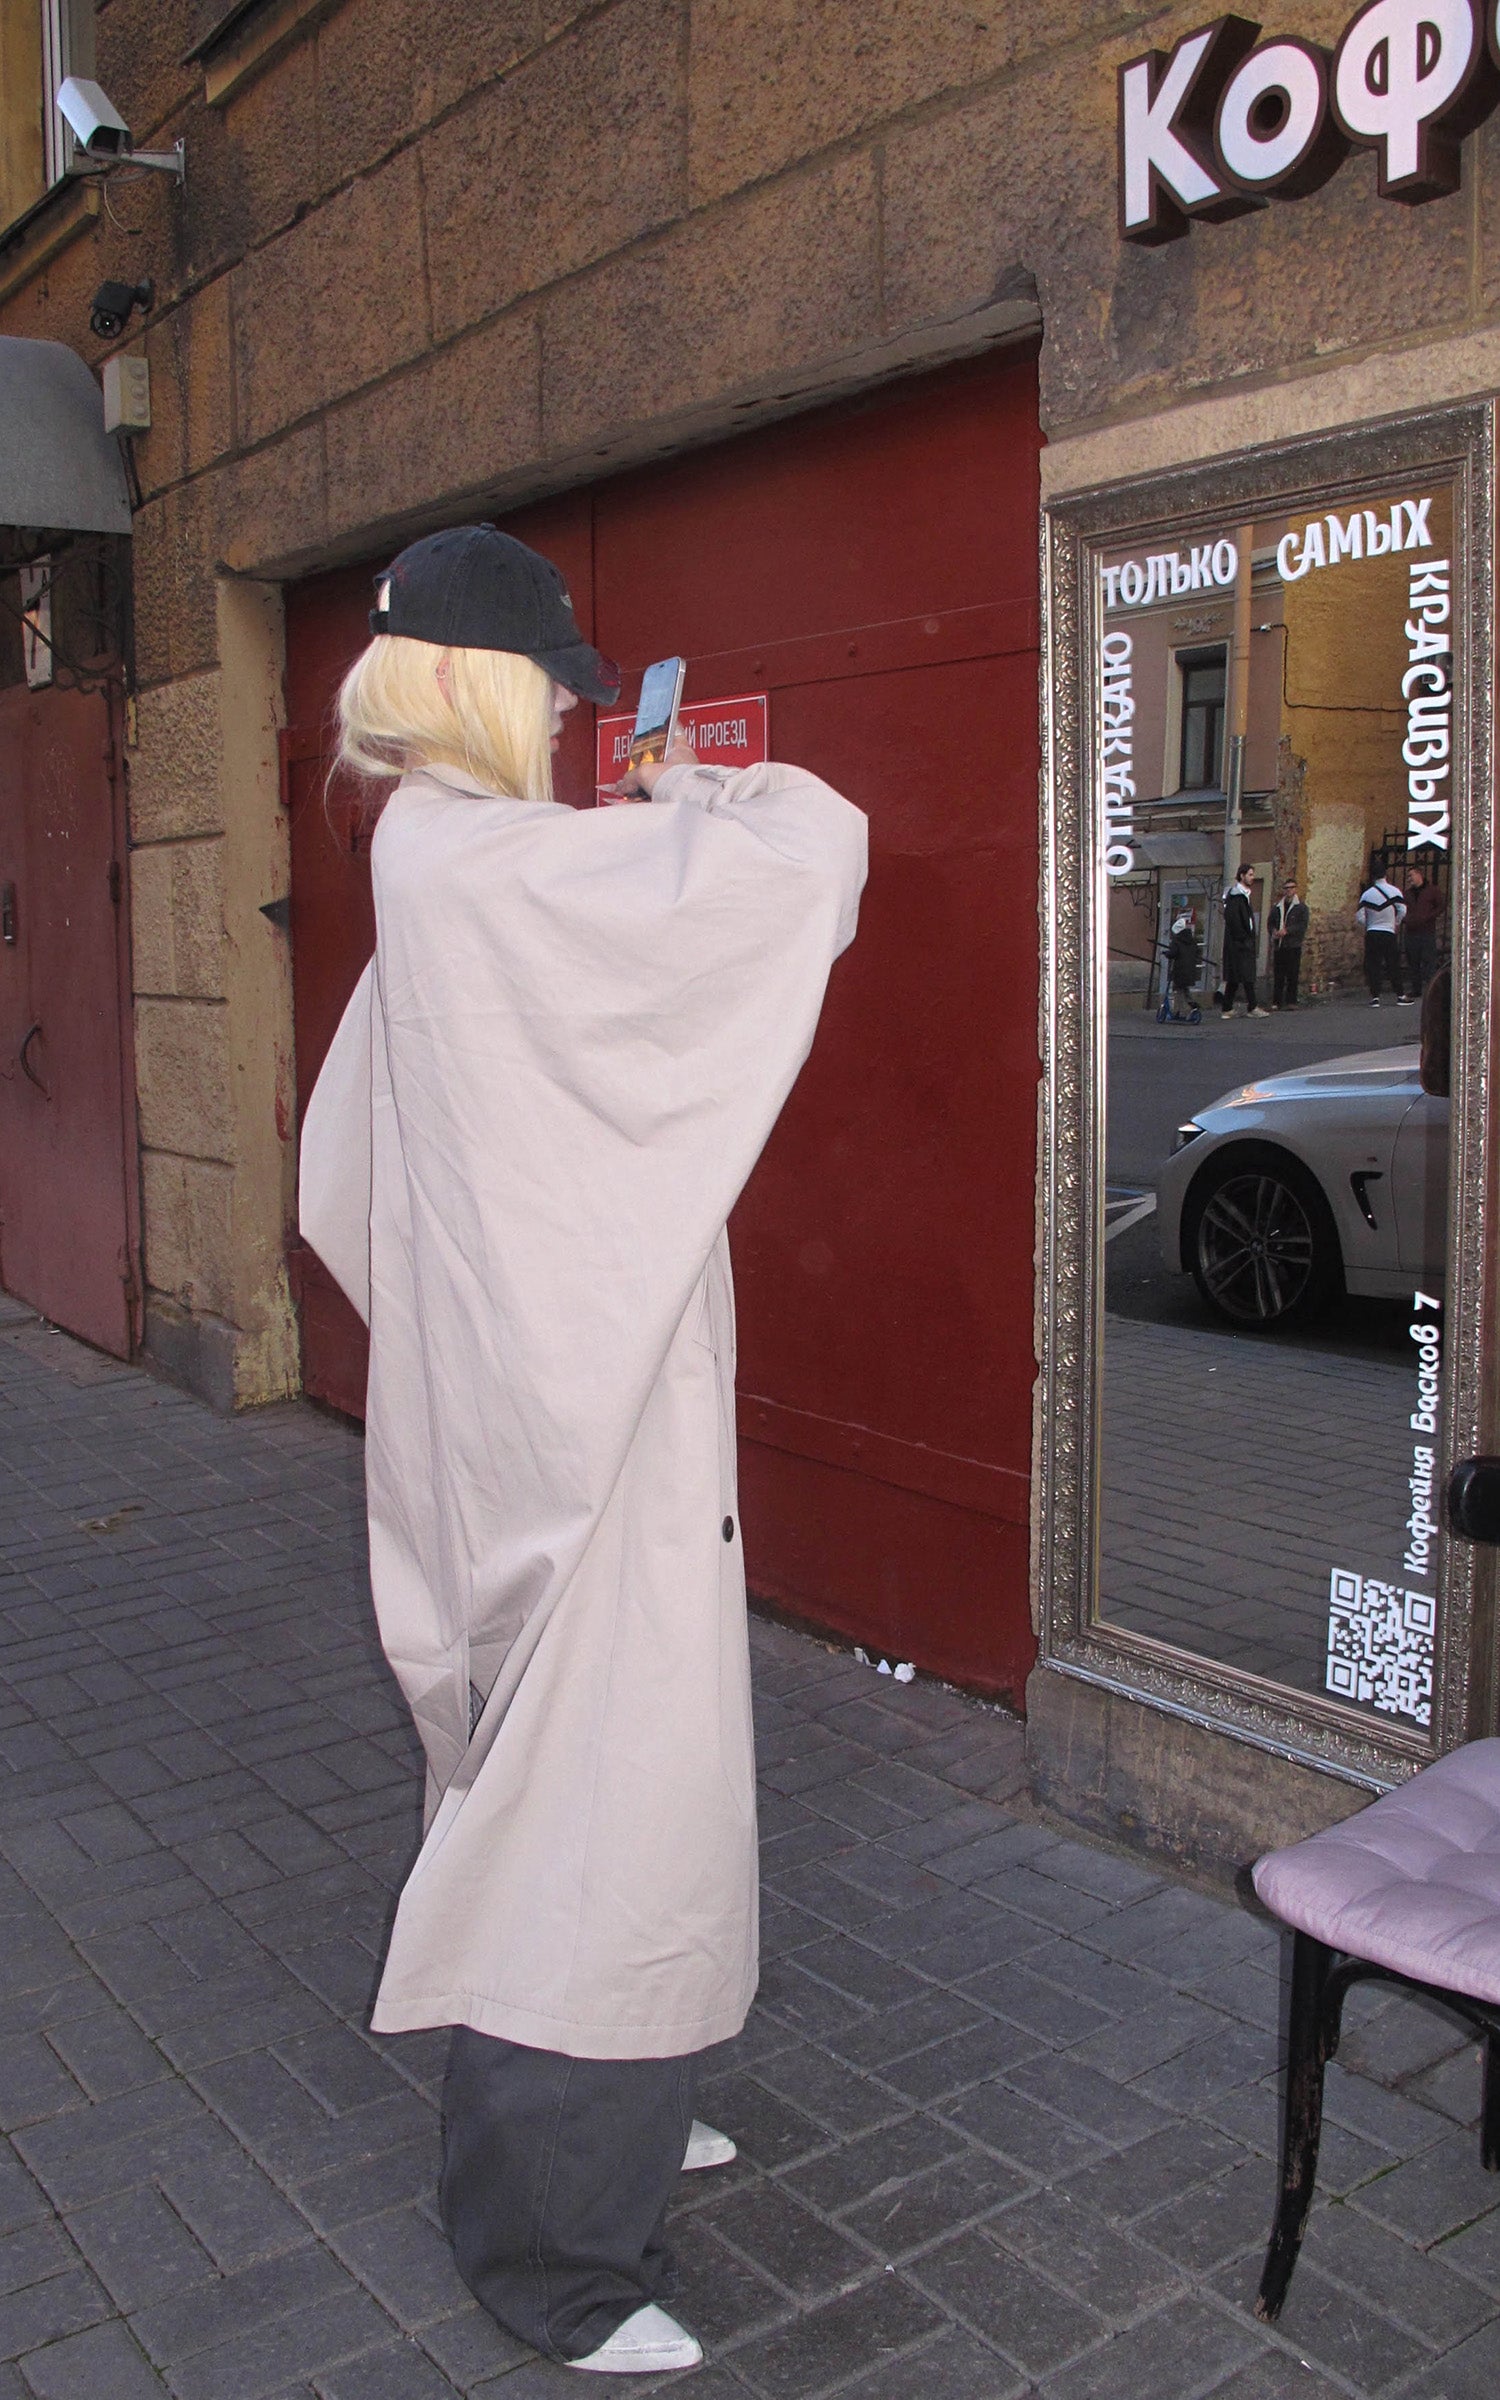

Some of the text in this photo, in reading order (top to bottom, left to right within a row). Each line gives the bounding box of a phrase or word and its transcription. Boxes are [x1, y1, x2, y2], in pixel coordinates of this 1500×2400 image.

[1103, 498, 1434, 607] ТОЛЬКО САМЫХ
[700, 718, 748, 749] ПРОЕЗД
[1102, 631, 1135, 876] ОТРАЖАЮ
[1402, 559, 1451, 851] КРАСИВЫХ
[1403, 1290, 1441, 1576] Кофейня Басков 7
